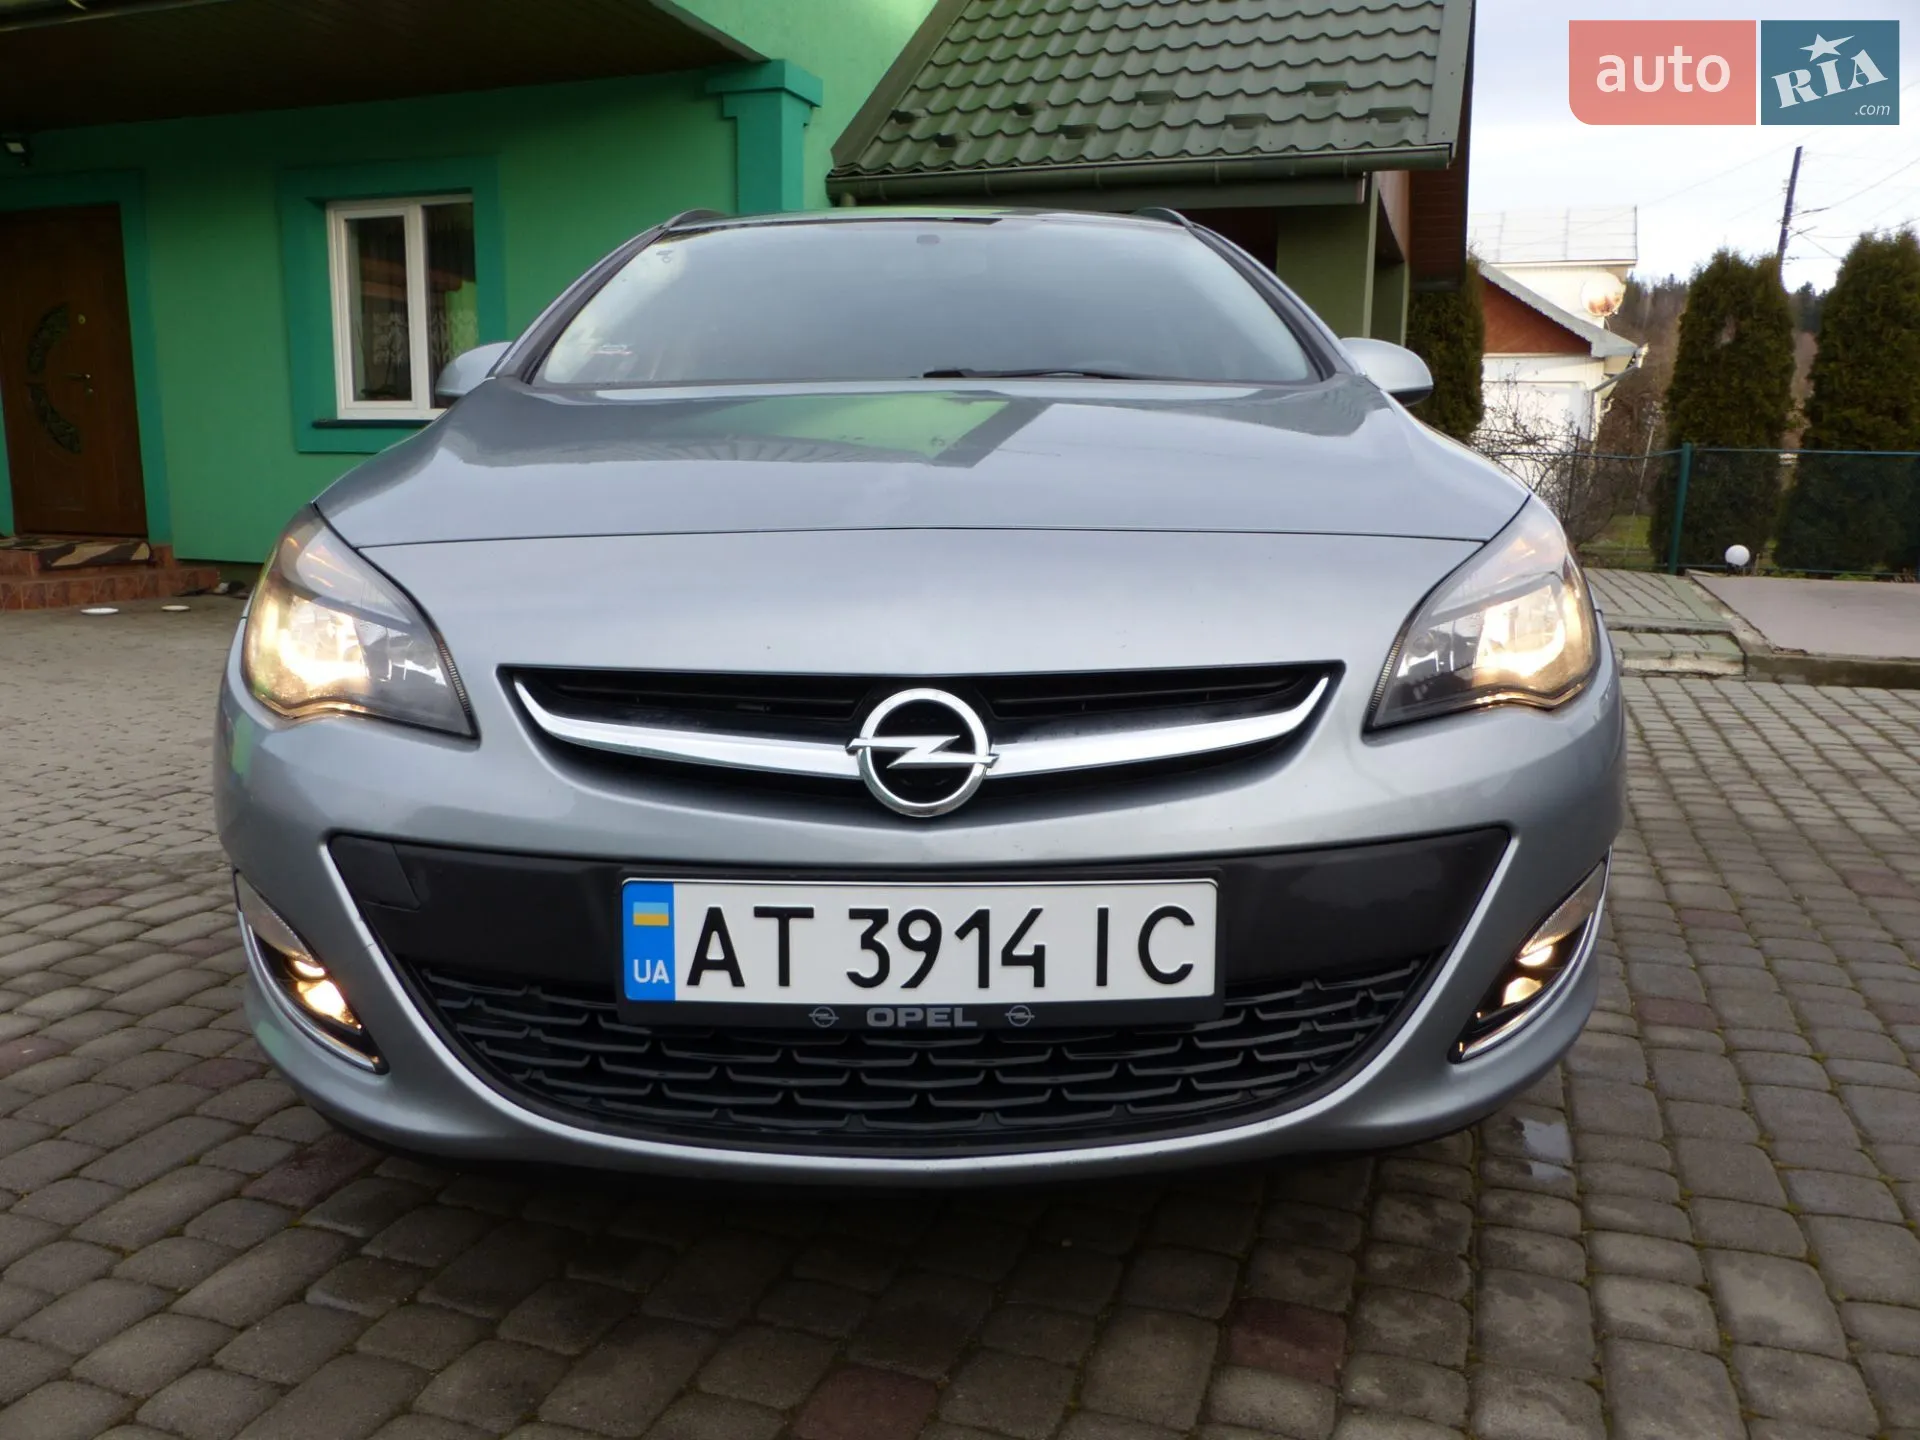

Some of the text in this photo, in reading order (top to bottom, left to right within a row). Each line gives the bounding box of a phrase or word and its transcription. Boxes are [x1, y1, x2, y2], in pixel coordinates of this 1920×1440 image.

[686, 904, 1195, 989] AT 3914 IC
[633, 959, 670, 984] UA
[866, 1007, 977, 1028] OPEL
